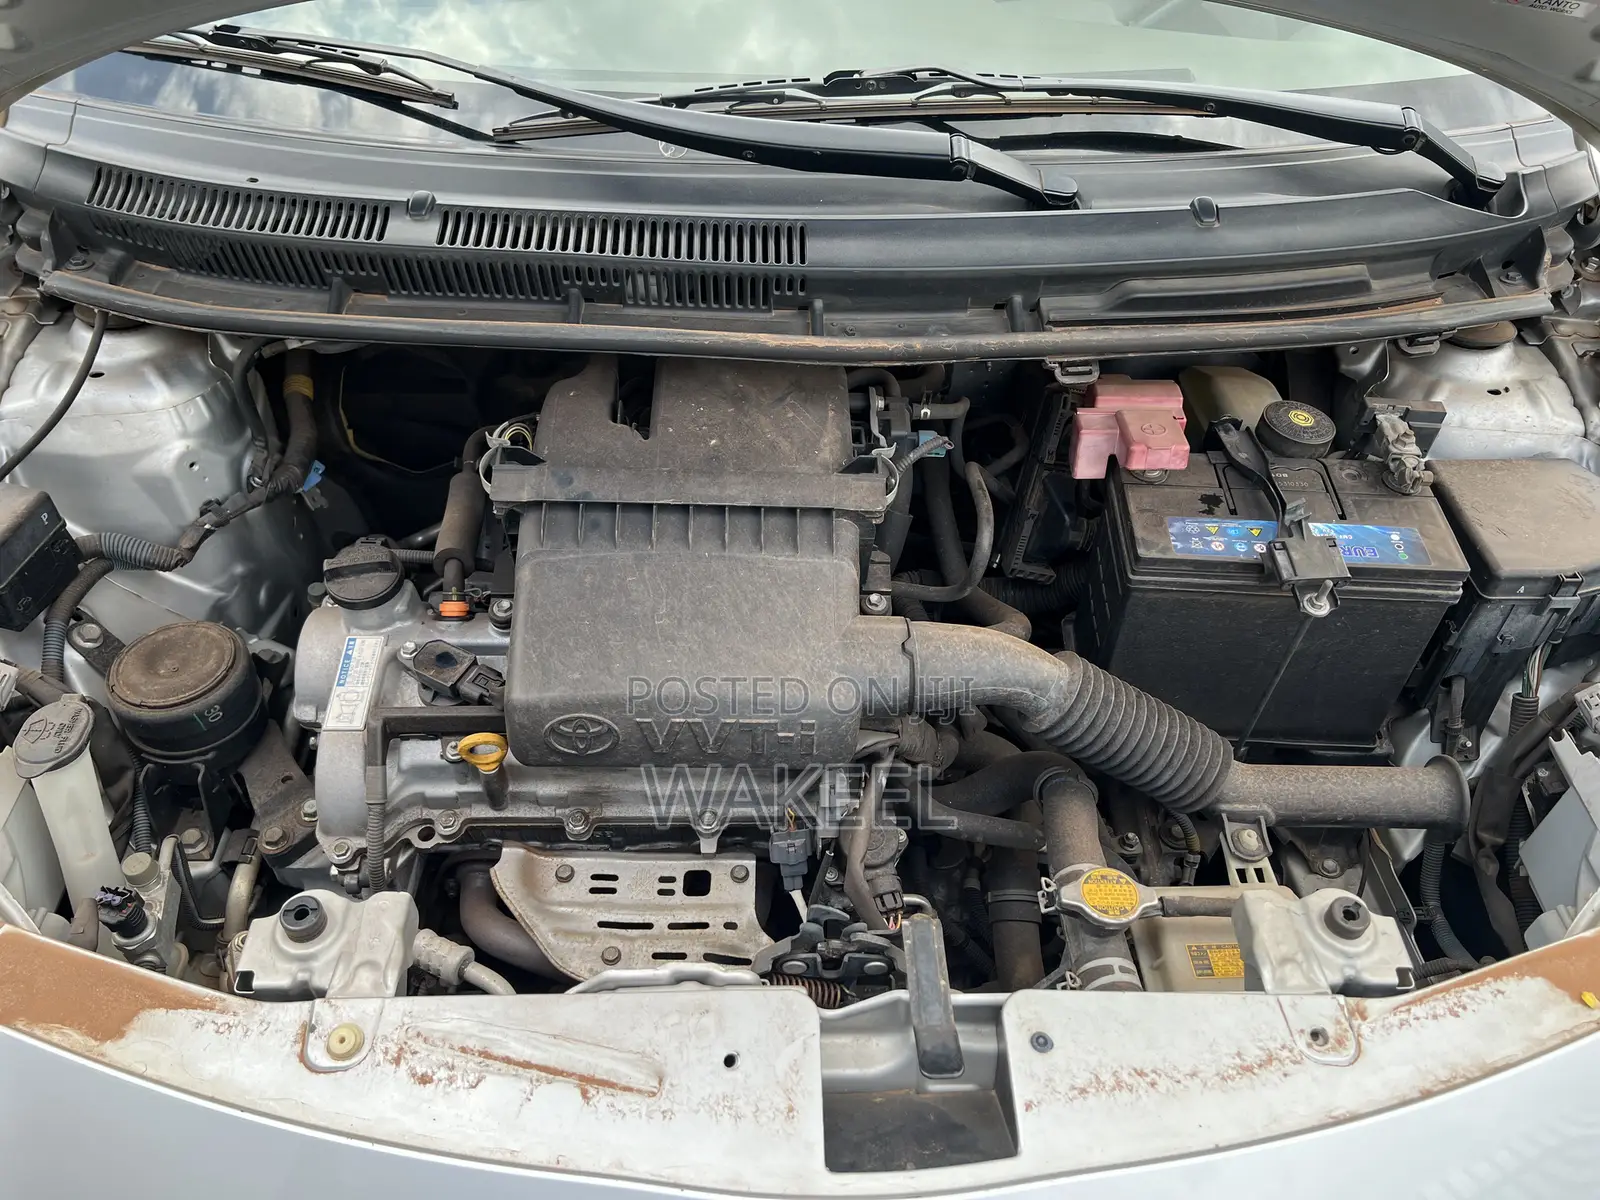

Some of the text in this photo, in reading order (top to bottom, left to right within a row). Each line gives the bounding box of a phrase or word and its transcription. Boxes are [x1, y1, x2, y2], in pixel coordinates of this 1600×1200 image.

[338, 657, 352, 686] NOTICE
[204, 704, 223, 723] 30
[634, 717, 817, 756] VVT-i
